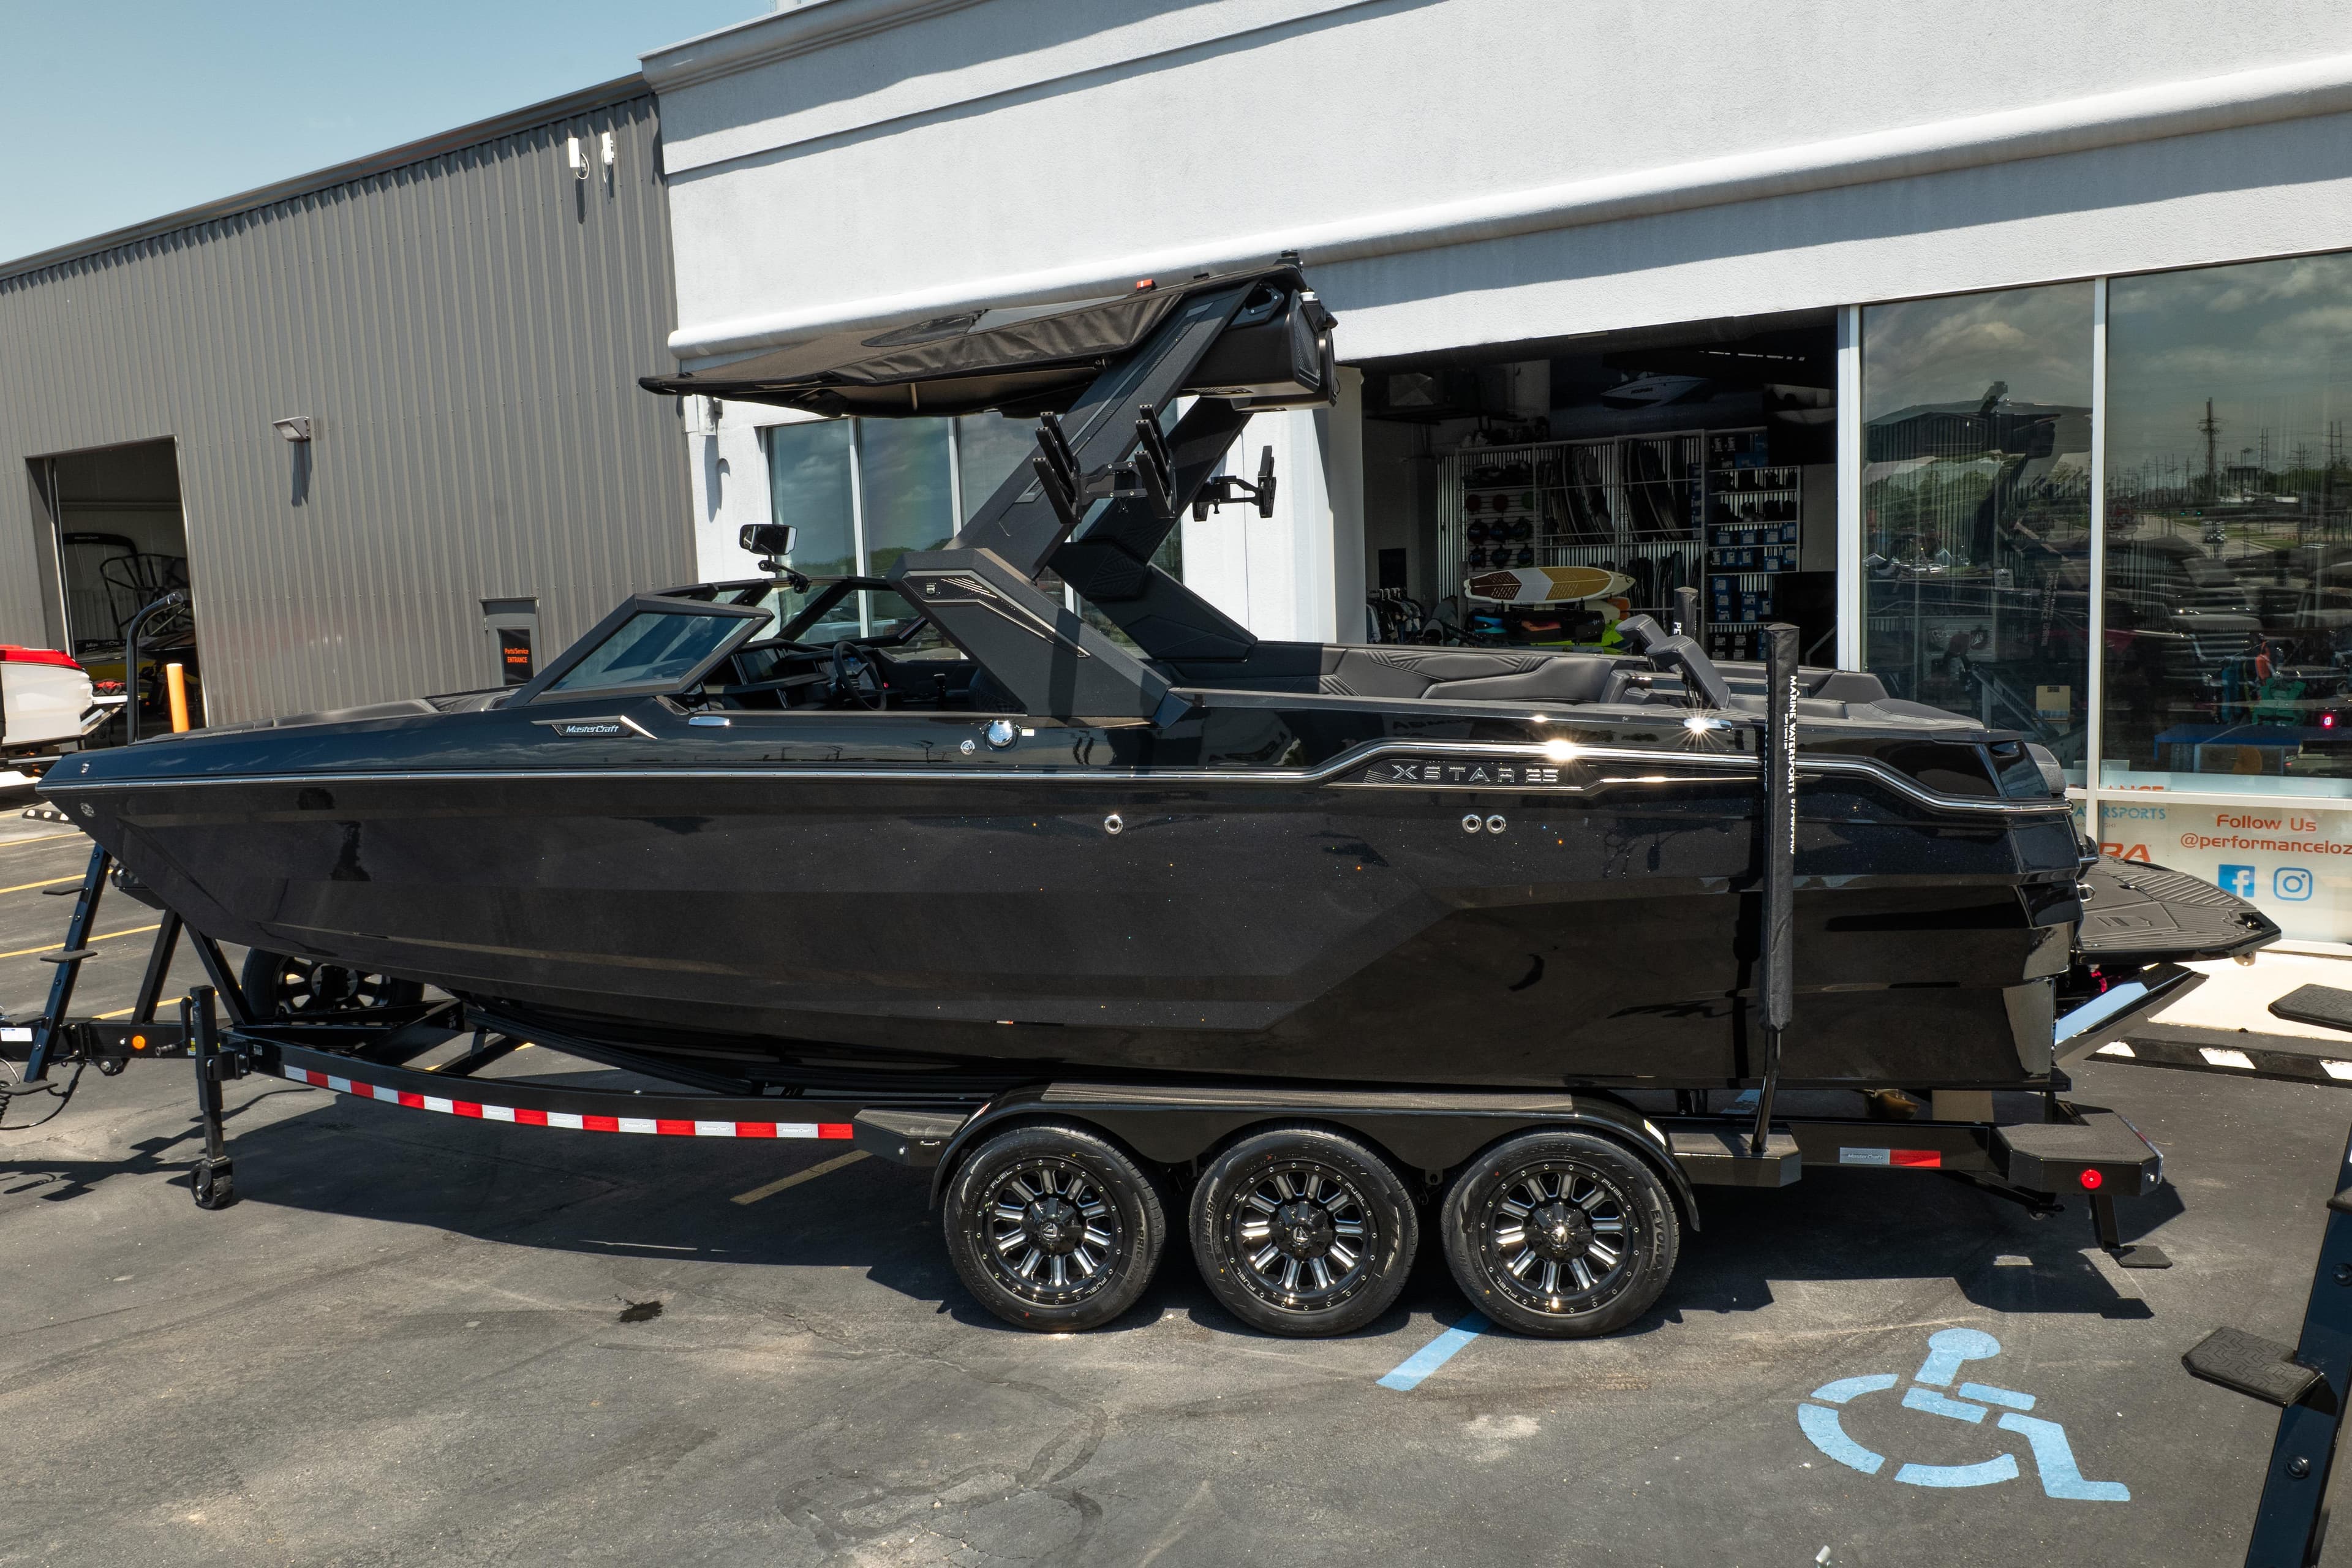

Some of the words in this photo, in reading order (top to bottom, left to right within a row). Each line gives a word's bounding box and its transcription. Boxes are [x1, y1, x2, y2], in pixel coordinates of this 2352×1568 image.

[1790, 675, 1800, 719] MARINE
[566, 725, 619, 734] MasterCraft
[1788, 721, 1797, 794] WATERSPORTS
[1392, 764, 1515, 783] XSTAR
[1525, 767, 1559, 784] 25
[2216, 814, 2282, 831] Follow
[2290, 817, 2317, 832] Us
[990, 1170, 1013, 1189] FUEL
[1601, 1178, 1624, 1202] FUEL
[1344, 1182, 1365, 1207] FUEL
[1084, 1276, 1108, 1294] FUEL
[1237, 1267, 1256, 1292] FUEL
[1496, 1275, 1518, 1299] FUEL
